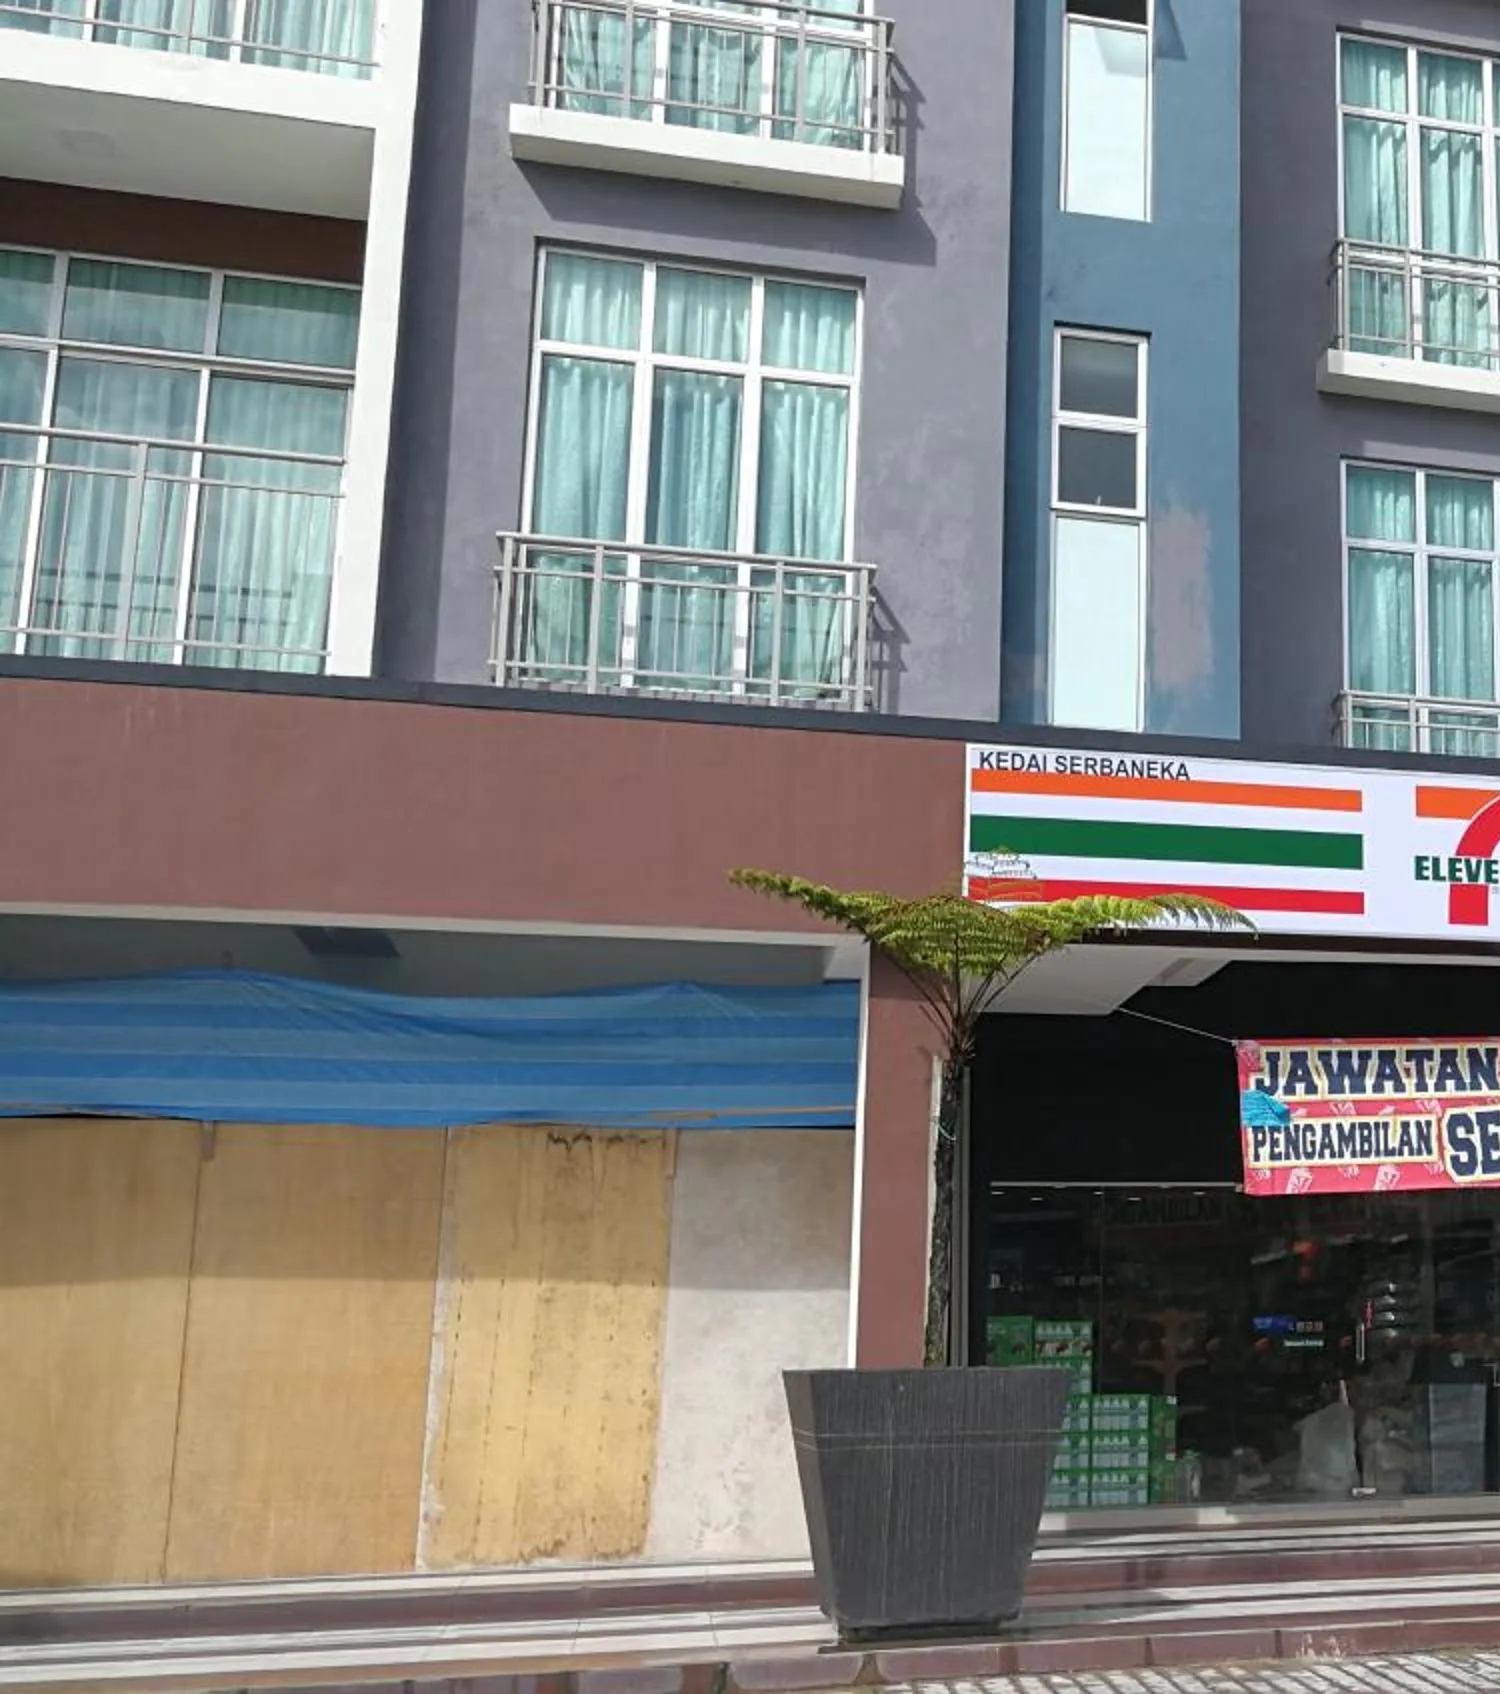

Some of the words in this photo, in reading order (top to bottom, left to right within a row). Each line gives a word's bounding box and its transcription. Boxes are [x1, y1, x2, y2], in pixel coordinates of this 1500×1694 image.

[979, 751, 1047, 773] KEDAI
[1055, 755, 1190, 780] SERBANEKA
[1255, 1046, 1500, 1096] JAWATAN
[1252, 1119, 1433, 1162] PENGAMBILAN
